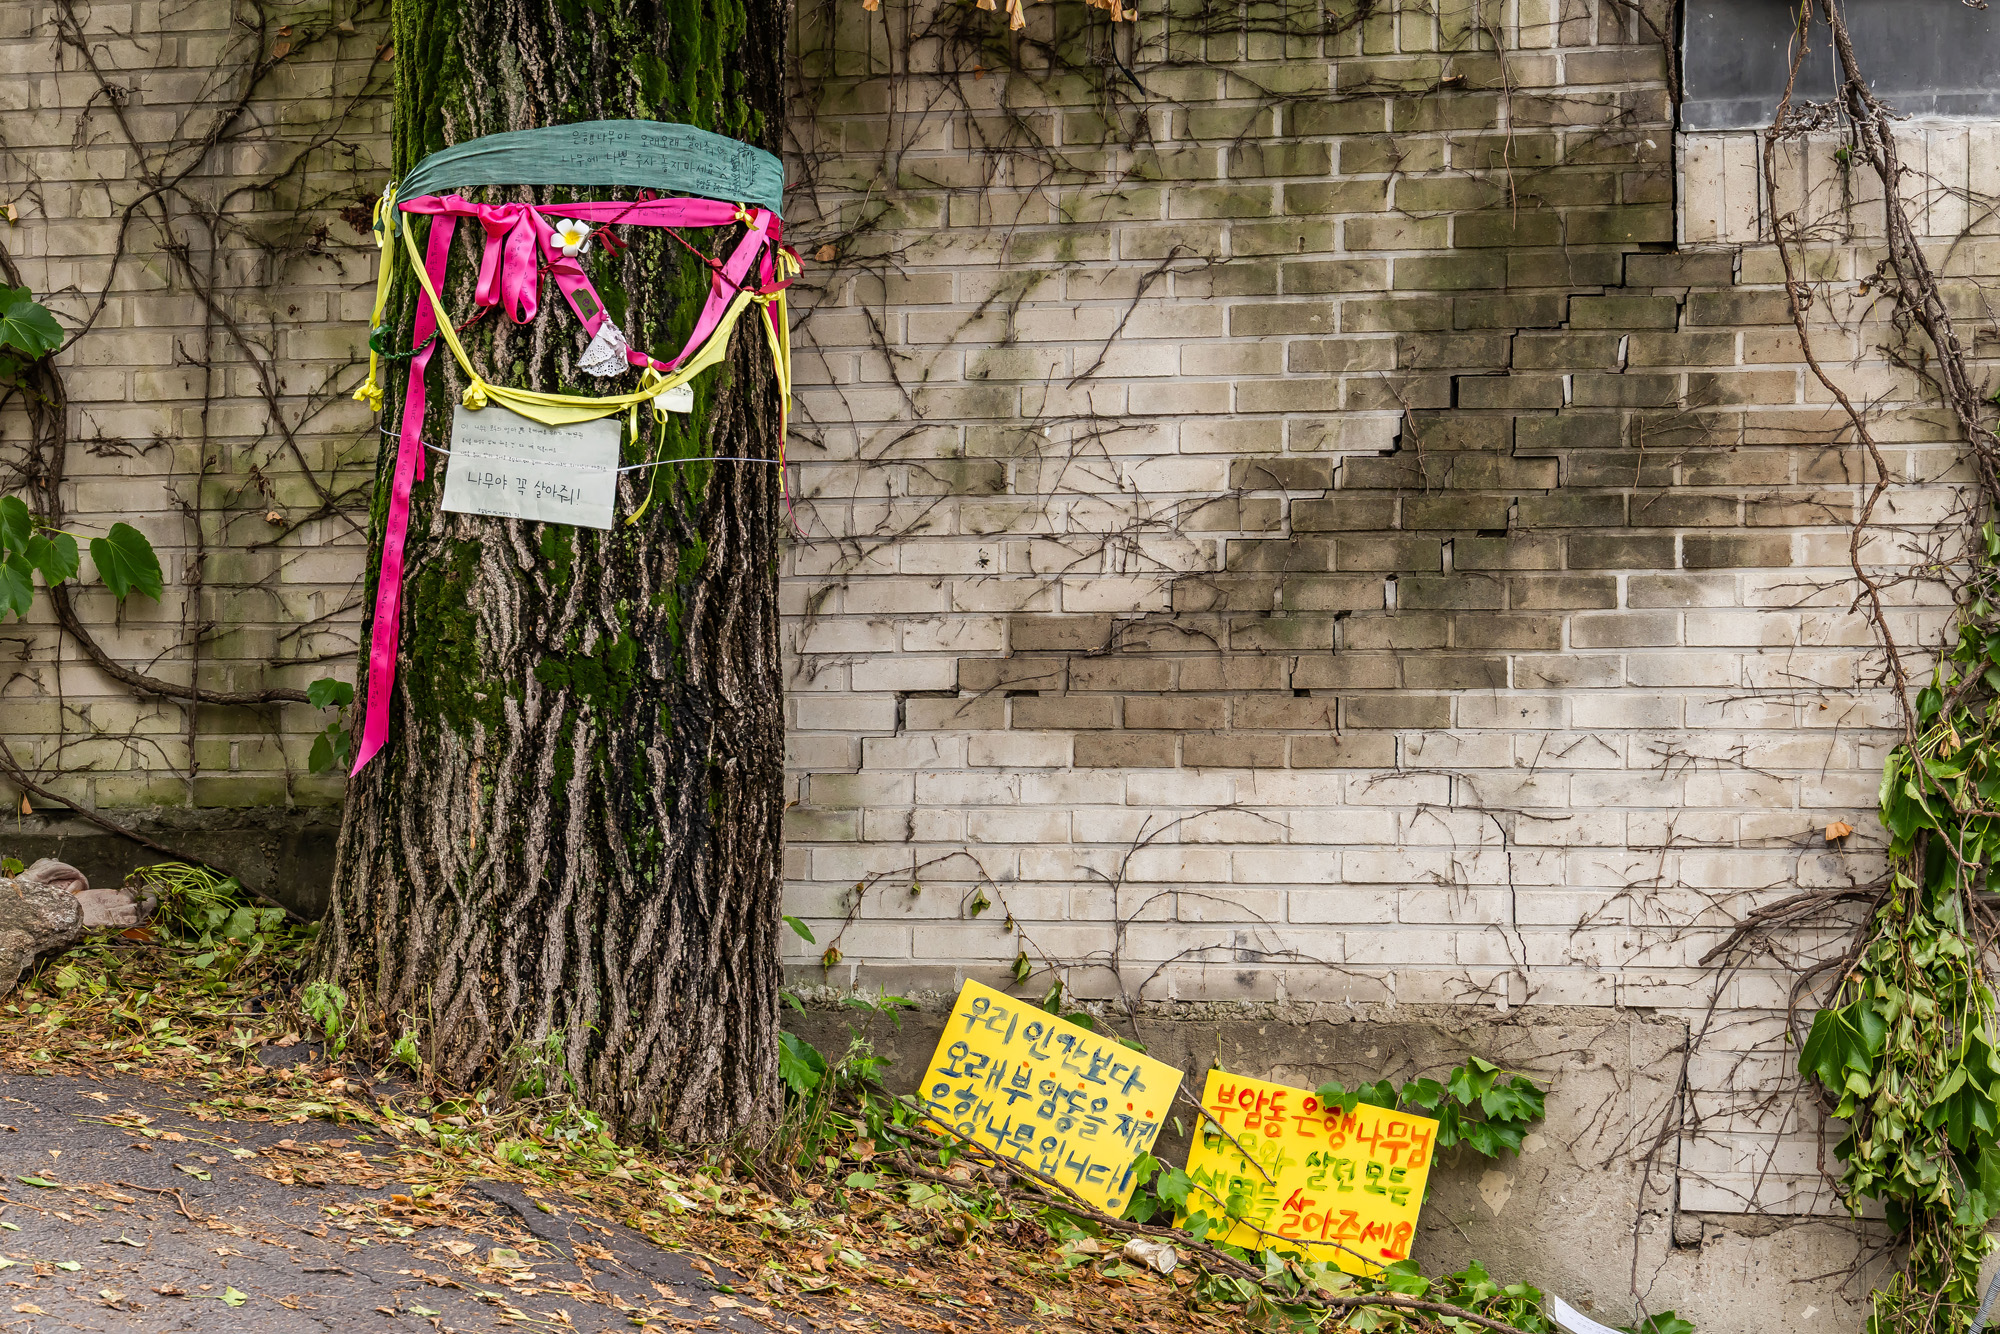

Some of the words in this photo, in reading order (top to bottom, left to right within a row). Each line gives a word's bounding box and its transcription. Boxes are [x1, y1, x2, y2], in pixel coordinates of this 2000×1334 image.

[572, 130, 631, 146] 은행나무야
[640, 134, 680, 149] 오래오래
[467, 472, 508, 490] 나무야
[516, 477, 527, 495] 꼭
[935, 1041, 1008, 1092] 오래
[1210, 1083, 1288, 1138] 부암동
[1305, 1150, 1357, 1192] 살던
[1363, 1160, 1412, 1207] 모든
[1277, 1187, 1413, 1260] 살아주세요
